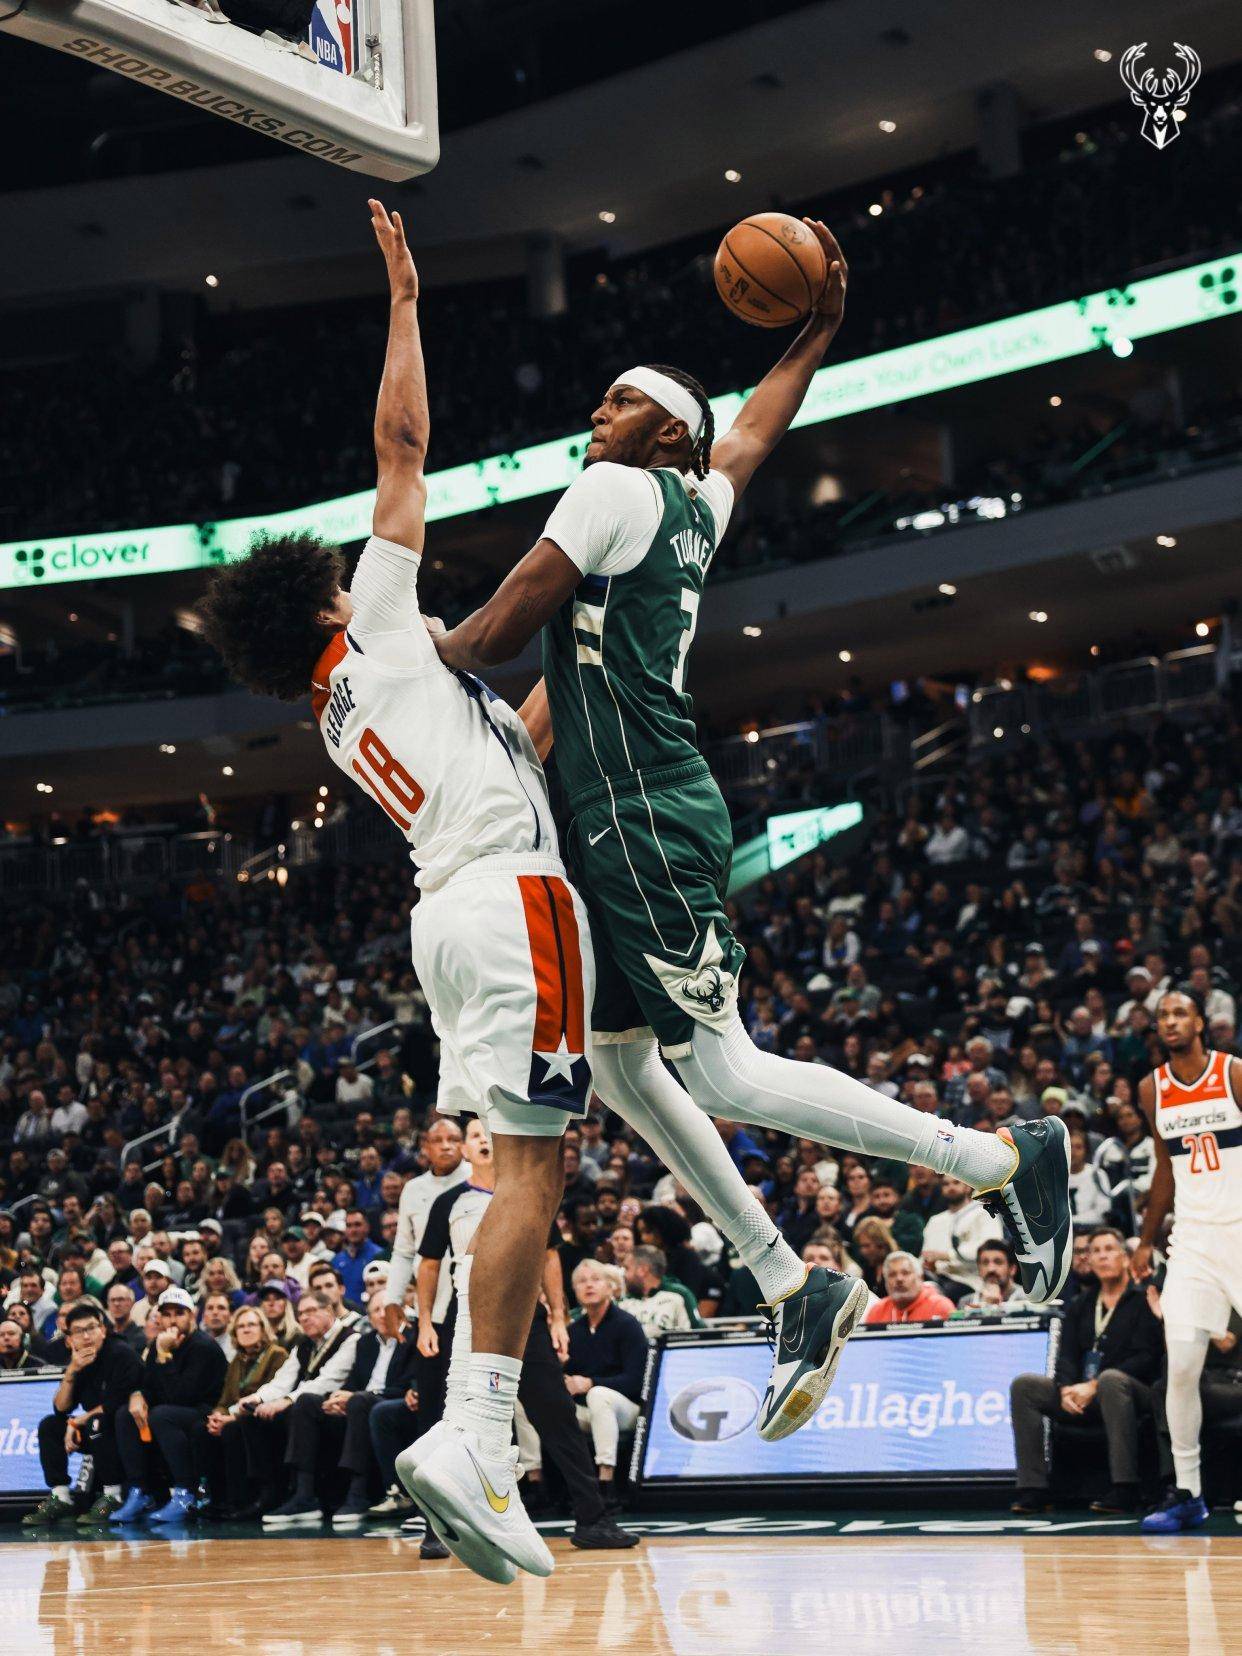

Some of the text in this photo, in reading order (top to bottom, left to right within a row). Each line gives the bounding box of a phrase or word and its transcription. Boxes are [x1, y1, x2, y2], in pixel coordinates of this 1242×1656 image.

[316, 36, 338, 65] NBA
[62, 38, 362, 164] SHOP.BUCKS.COM
[52, 541, 149, 570] clover
[669, 528, 715, 581] TURNE
[326, 676, 357, 749] GEORGE
[352, 727, 427, 831] 18
[1163, 1107, 1227, 1132] wizards
[1182, 1132, 1221, 1174] 20
[802, 1380, 1013, 1438] allaghe
